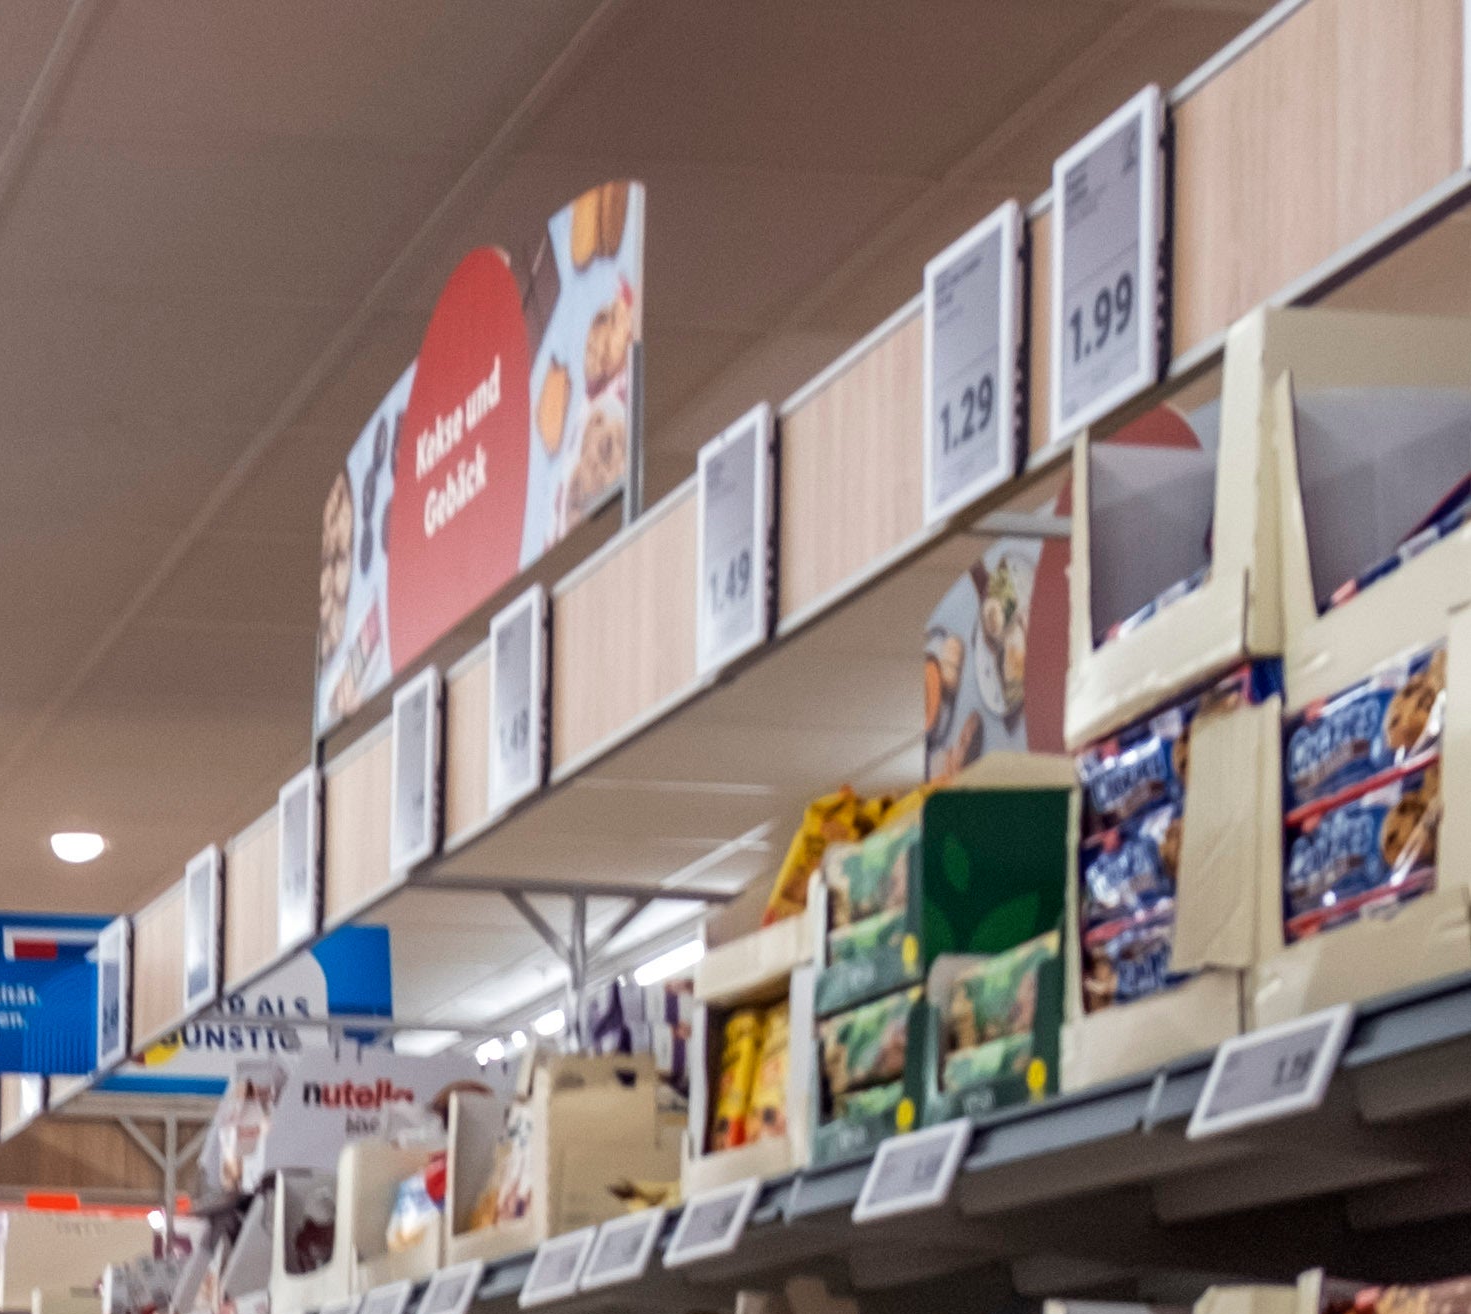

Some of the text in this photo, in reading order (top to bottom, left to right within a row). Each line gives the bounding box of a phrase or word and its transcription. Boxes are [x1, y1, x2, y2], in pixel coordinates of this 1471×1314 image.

[1069, 272, 1134, 363] 1.99
[416, 354, 501, 482] Kekse und
[940, 372, 994, 456] 1.29
[424, 442, 486, 539] Gebäck
[303, 1078, 414, 1108] nutella
